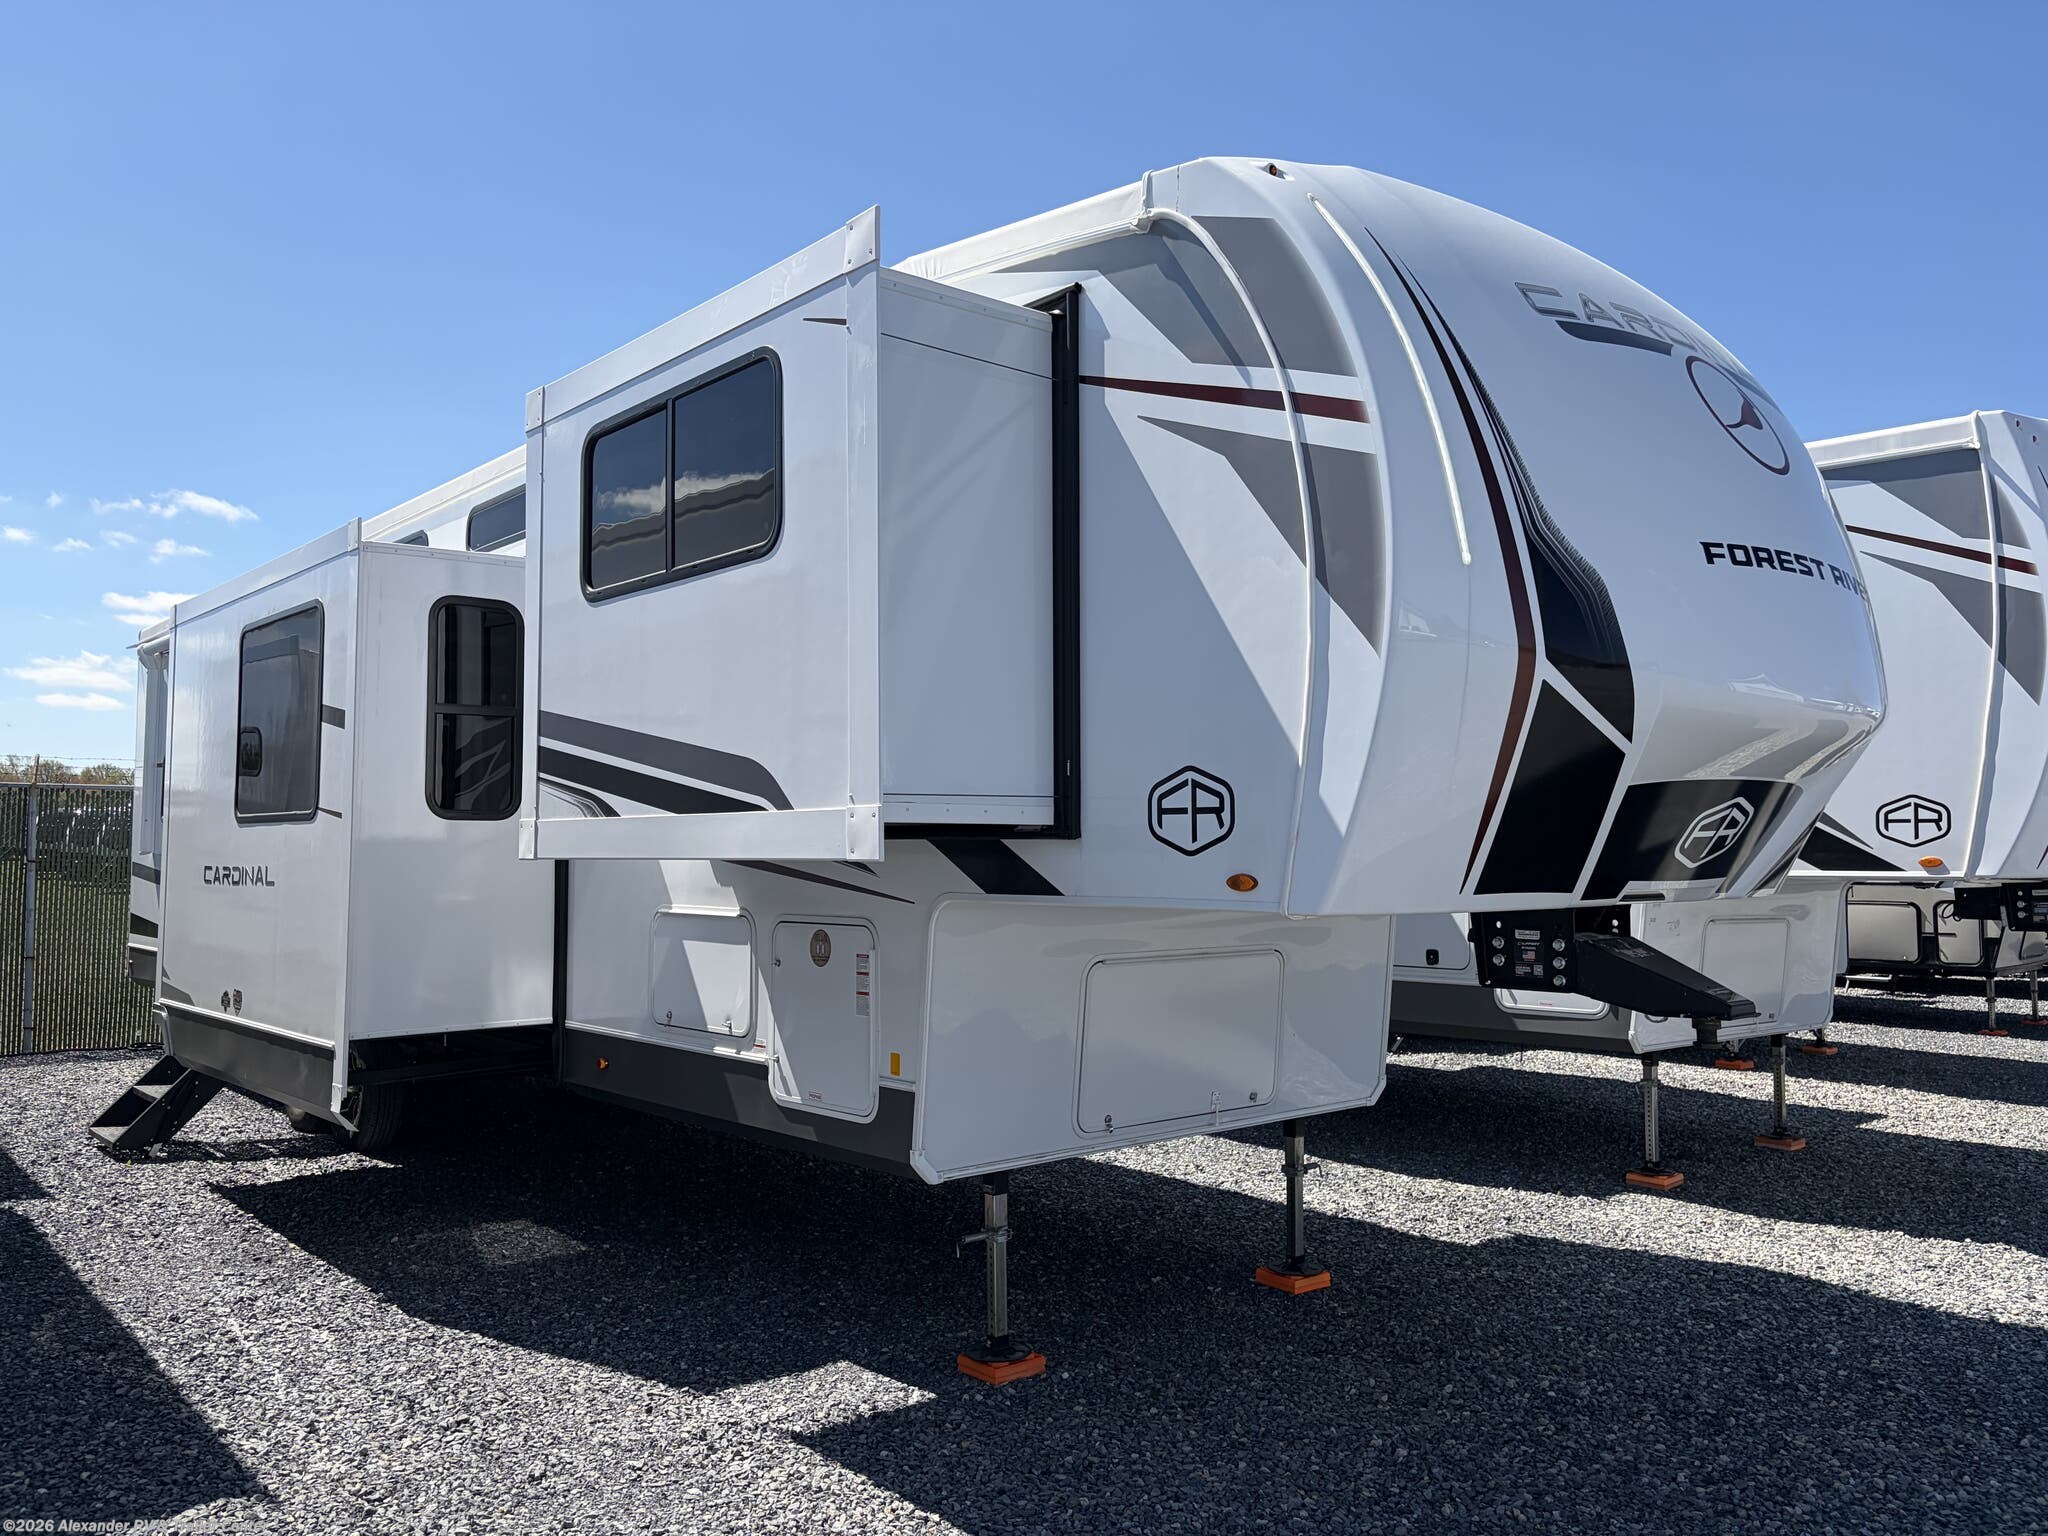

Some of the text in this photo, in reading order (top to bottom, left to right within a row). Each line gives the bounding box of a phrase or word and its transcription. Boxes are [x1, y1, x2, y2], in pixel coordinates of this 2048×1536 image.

[1699, 541, 1825, 580] FOREST
[1157, 778, 1225, 844] FR
[1884, 802, 1943, 840] FR
[203, 865, 275, 887] CARDINAL
